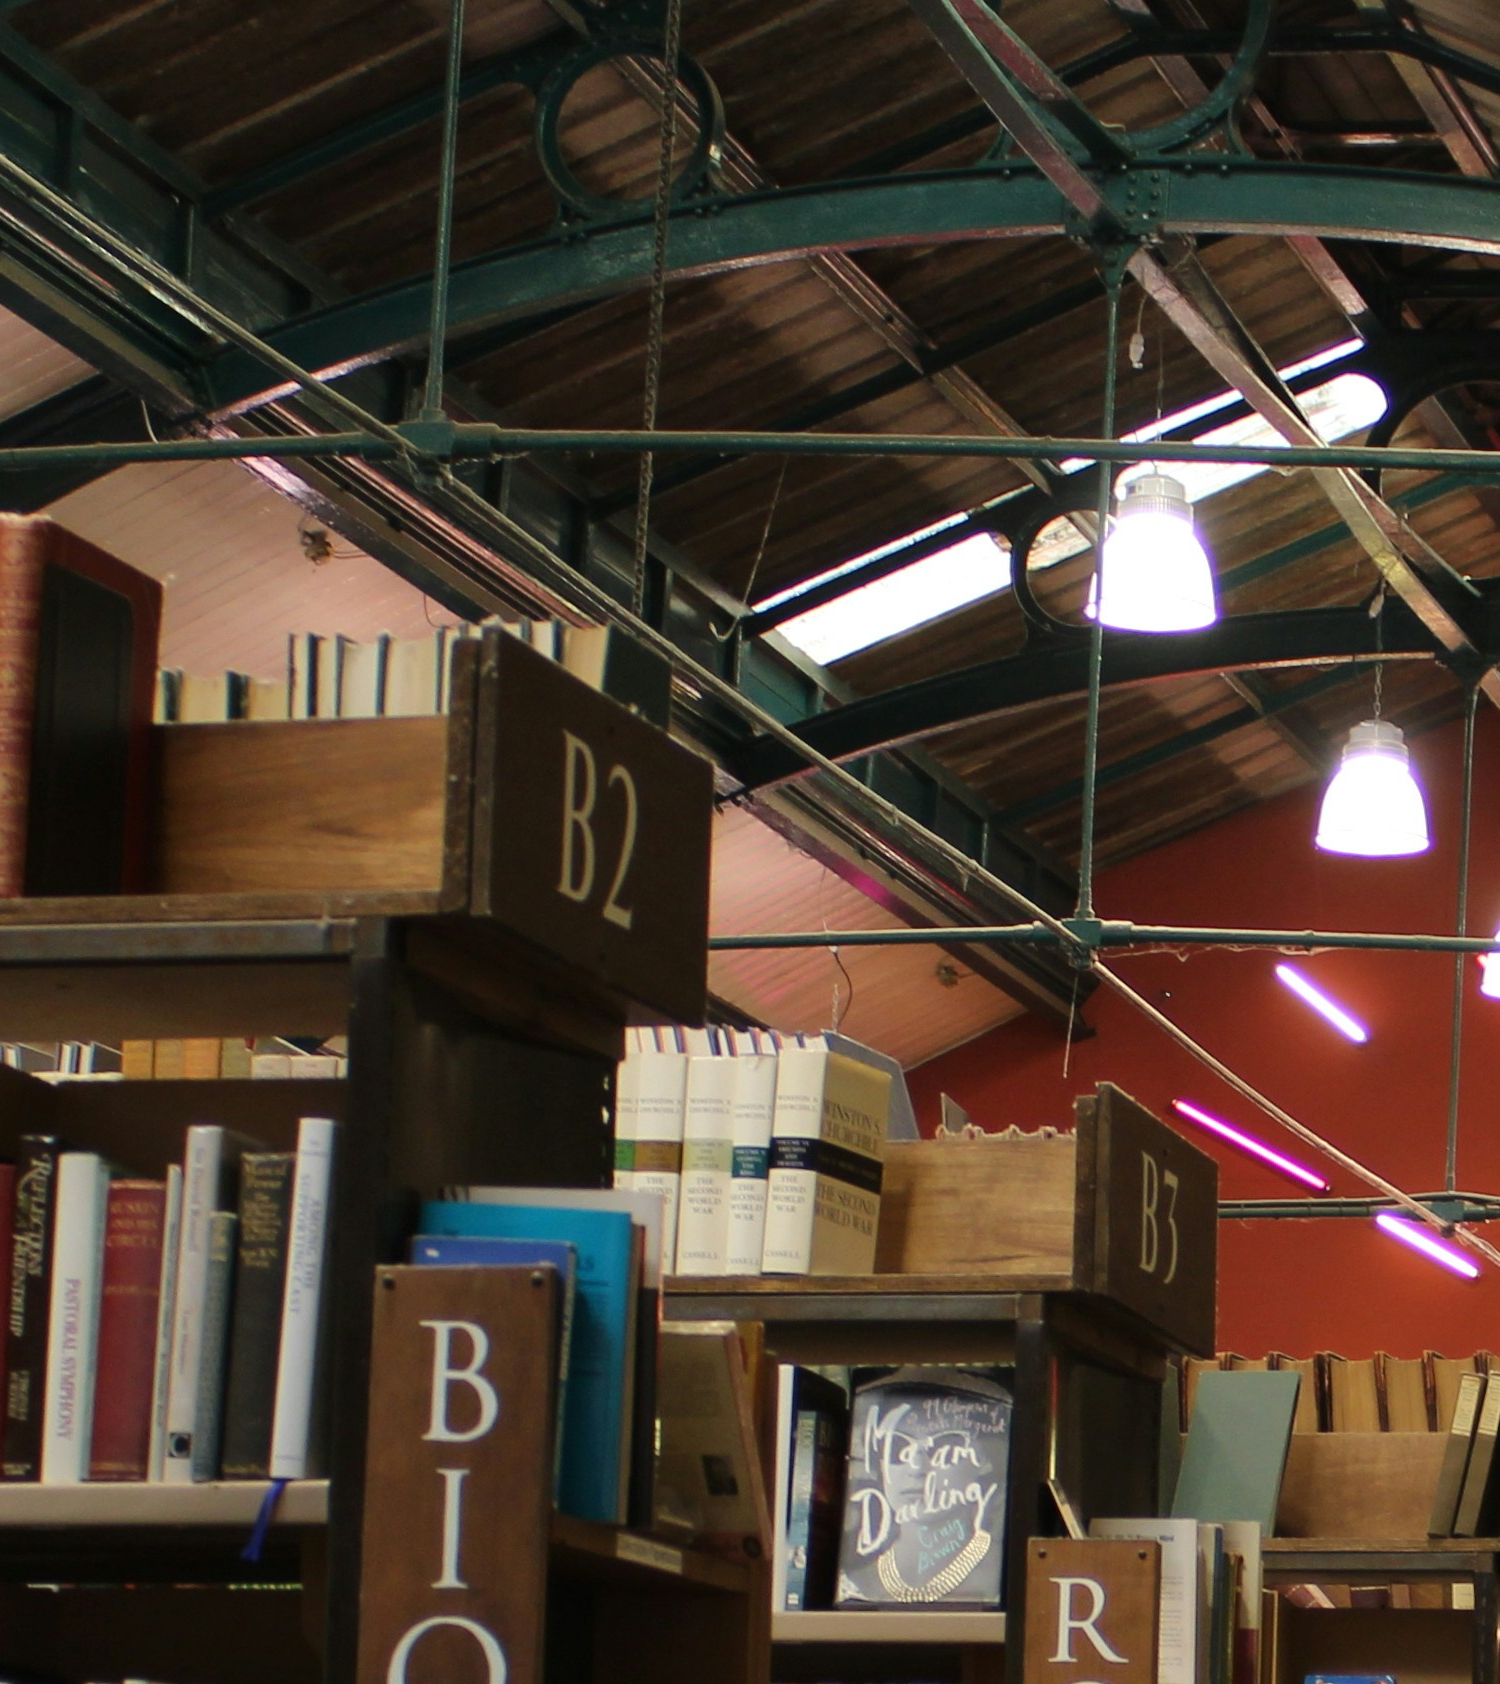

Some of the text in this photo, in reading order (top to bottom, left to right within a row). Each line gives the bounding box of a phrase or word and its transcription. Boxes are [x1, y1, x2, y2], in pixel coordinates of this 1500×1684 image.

[556, 728, 640, 932] B2
[697, 1177, 713, 1185] THE
[781, 1175, 798, 1183] THE
[687, 1197, 722, 1205] WORLD
[772, 1195, 805, 1203] WORLD
[692, 1207, 714, 1215] WAR
[776, 1205, 798, 1213] WAR
[734, 1213, 755, 1221] WAR
[1140, 1150, 1181, 1285] B3
[55, 1278, 81, 1440] PASTORAL SYMPHONY
[853, 1477, 999, 1556] Darling
[918, 1516, 967, 1550] Craig
[917, 1540, 962, 1576] Brown
